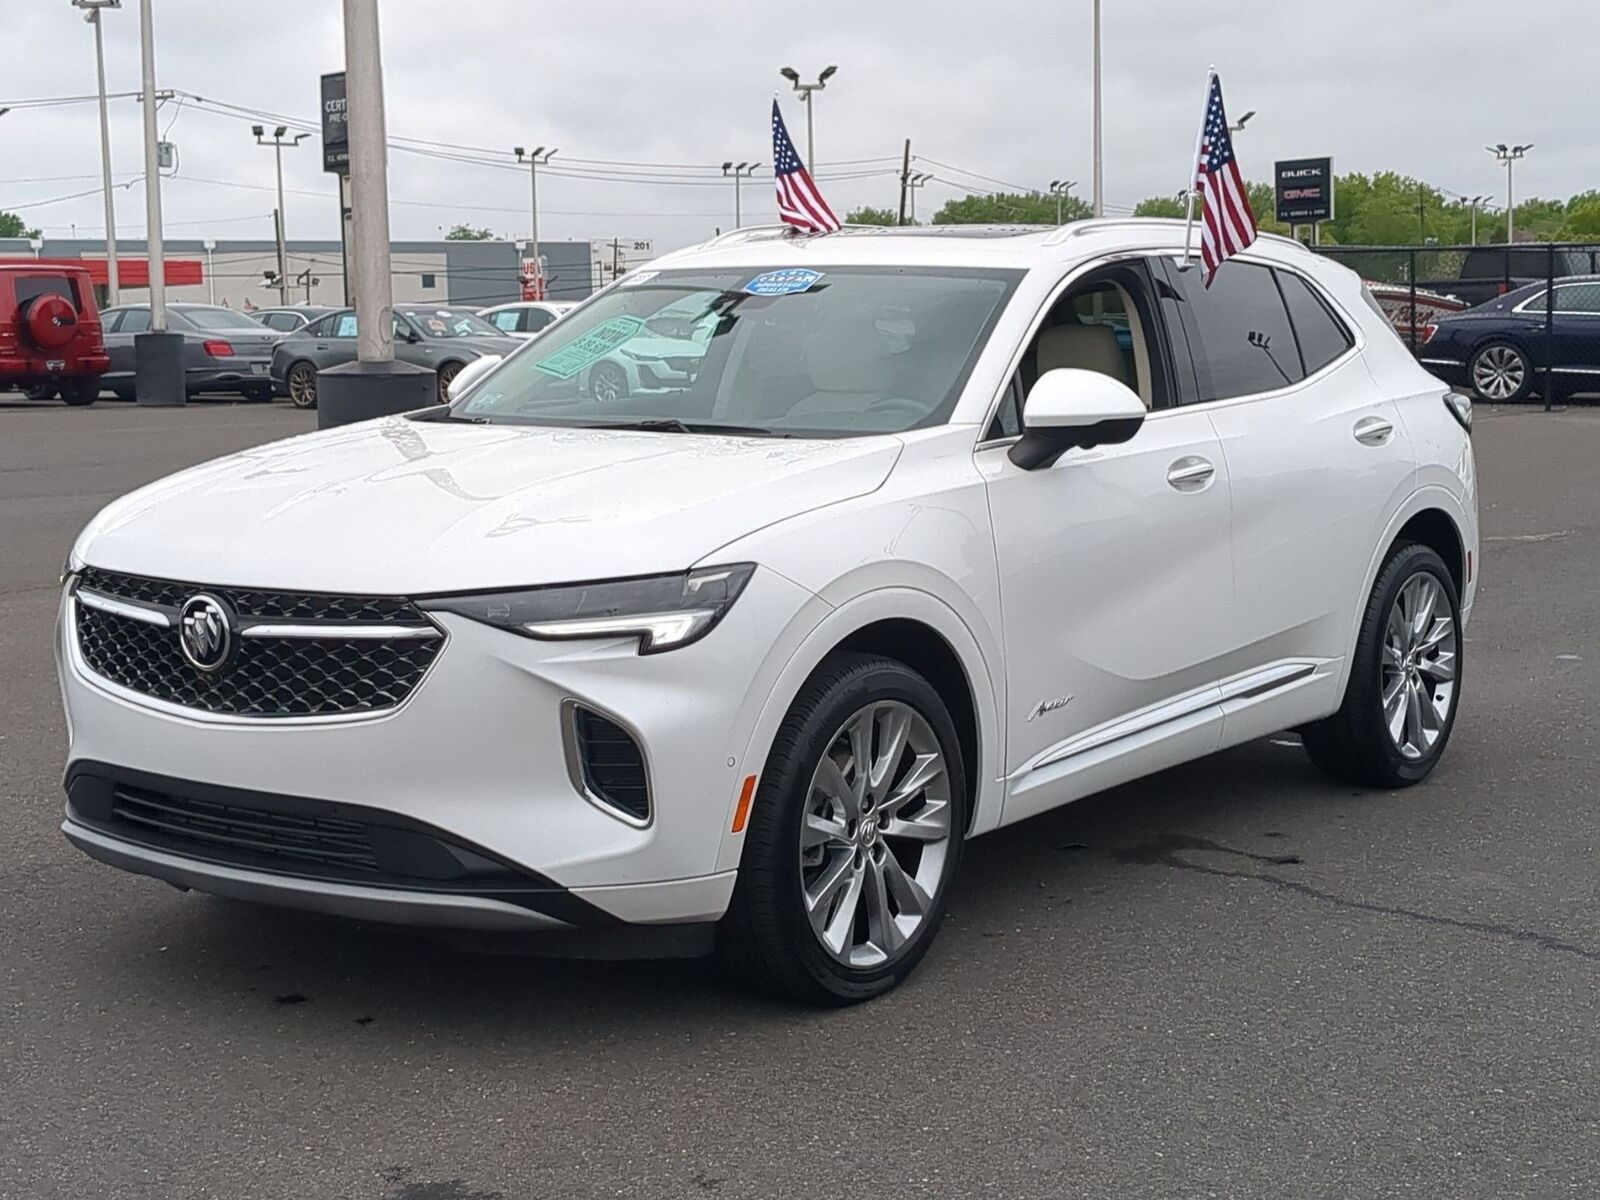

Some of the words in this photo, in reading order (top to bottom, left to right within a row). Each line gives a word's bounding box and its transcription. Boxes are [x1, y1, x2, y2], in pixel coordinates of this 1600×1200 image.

[325, 99, 346, 112] CERT
[1281, 168, 1322, 179] BUICK
[1283, 188, 1321, 199] GMC
[634, 242, 650, 250] 201
